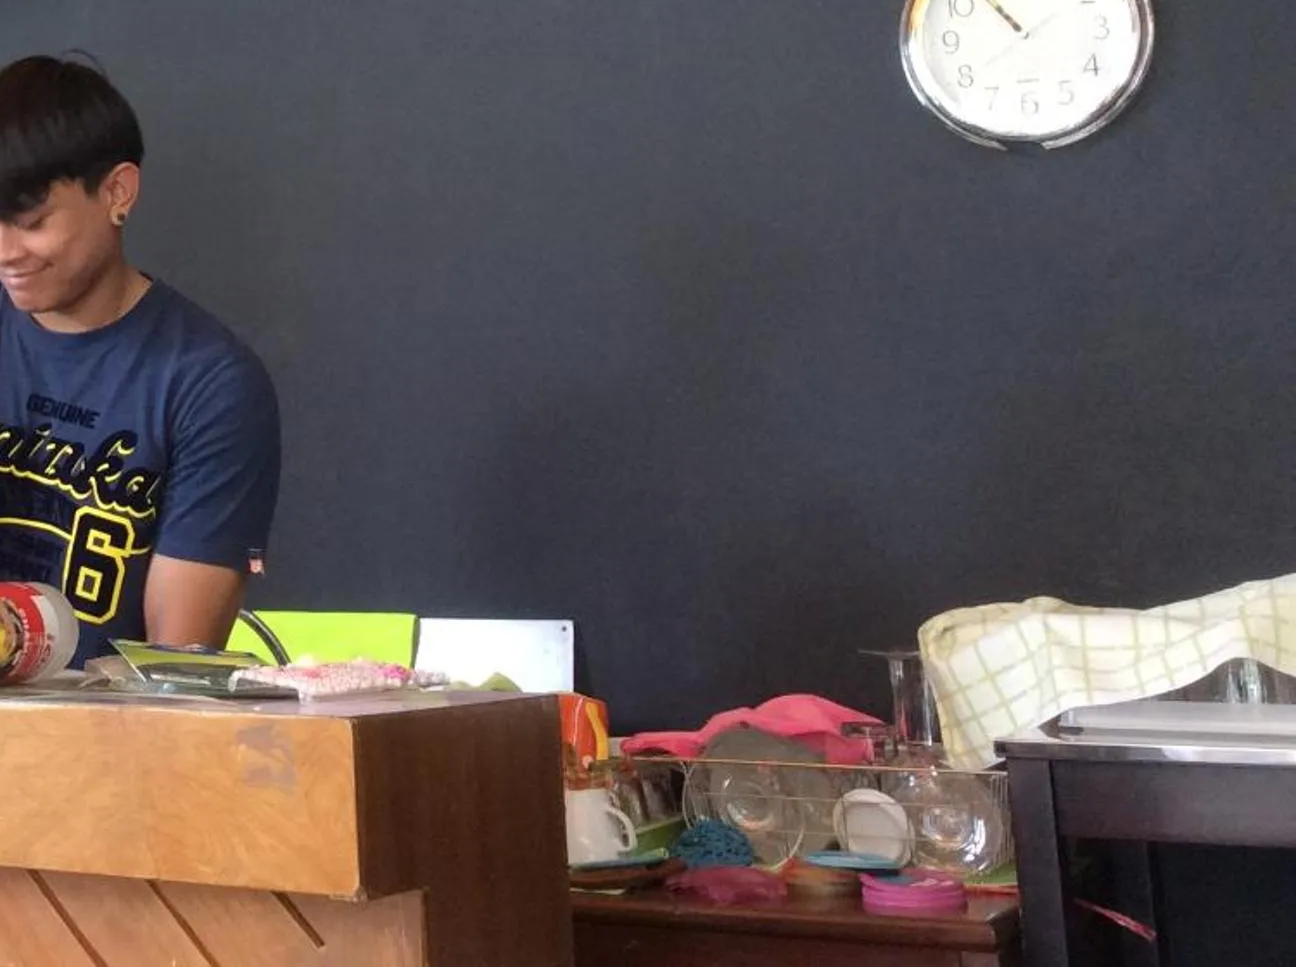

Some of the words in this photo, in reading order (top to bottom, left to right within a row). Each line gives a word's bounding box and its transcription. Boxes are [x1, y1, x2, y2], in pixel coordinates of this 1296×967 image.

[1095, 15, 1110, 40] 3
[942, 30, 960, 55] 9
[957, 64, 974, 89] 8
[1083, 53, 1100, 77] 4
[984, 86, 999, 111] 7
[26, 393, 101, 430] GENUINE
